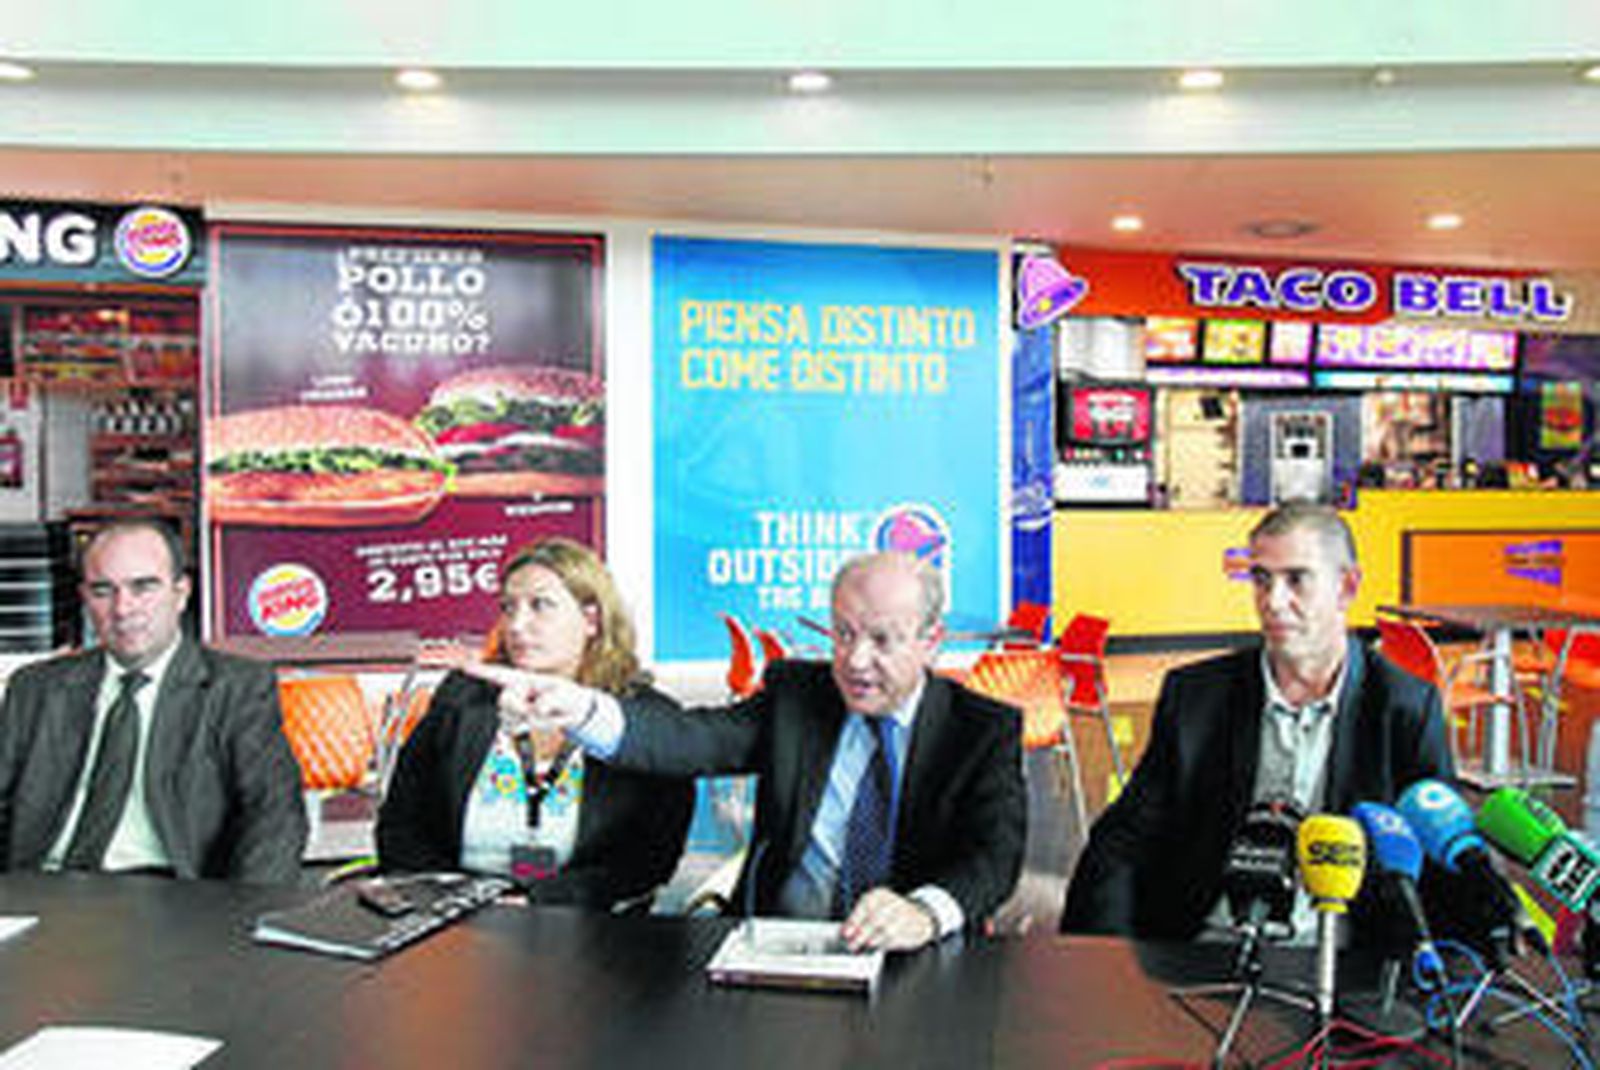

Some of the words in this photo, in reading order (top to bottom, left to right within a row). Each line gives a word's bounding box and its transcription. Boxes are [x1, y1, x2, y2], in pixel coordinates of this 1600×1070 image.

[337, 265, 485, 296] POLLO
[1178, 262, 1377, 314] TACO
[1392, 274, 1572, 319] BELL
[679, 299, 810, 344] PIENSA
[820, 304, 977, 350] DISTINTO
[680, 348, 781, 391] COME
[790, 350, 949, 394] DISTINTO
[757, 511, 862, 546] THINK
[367, 561, 499, 602] 2,95€
[708, 549, 843, 585] OUTSID
